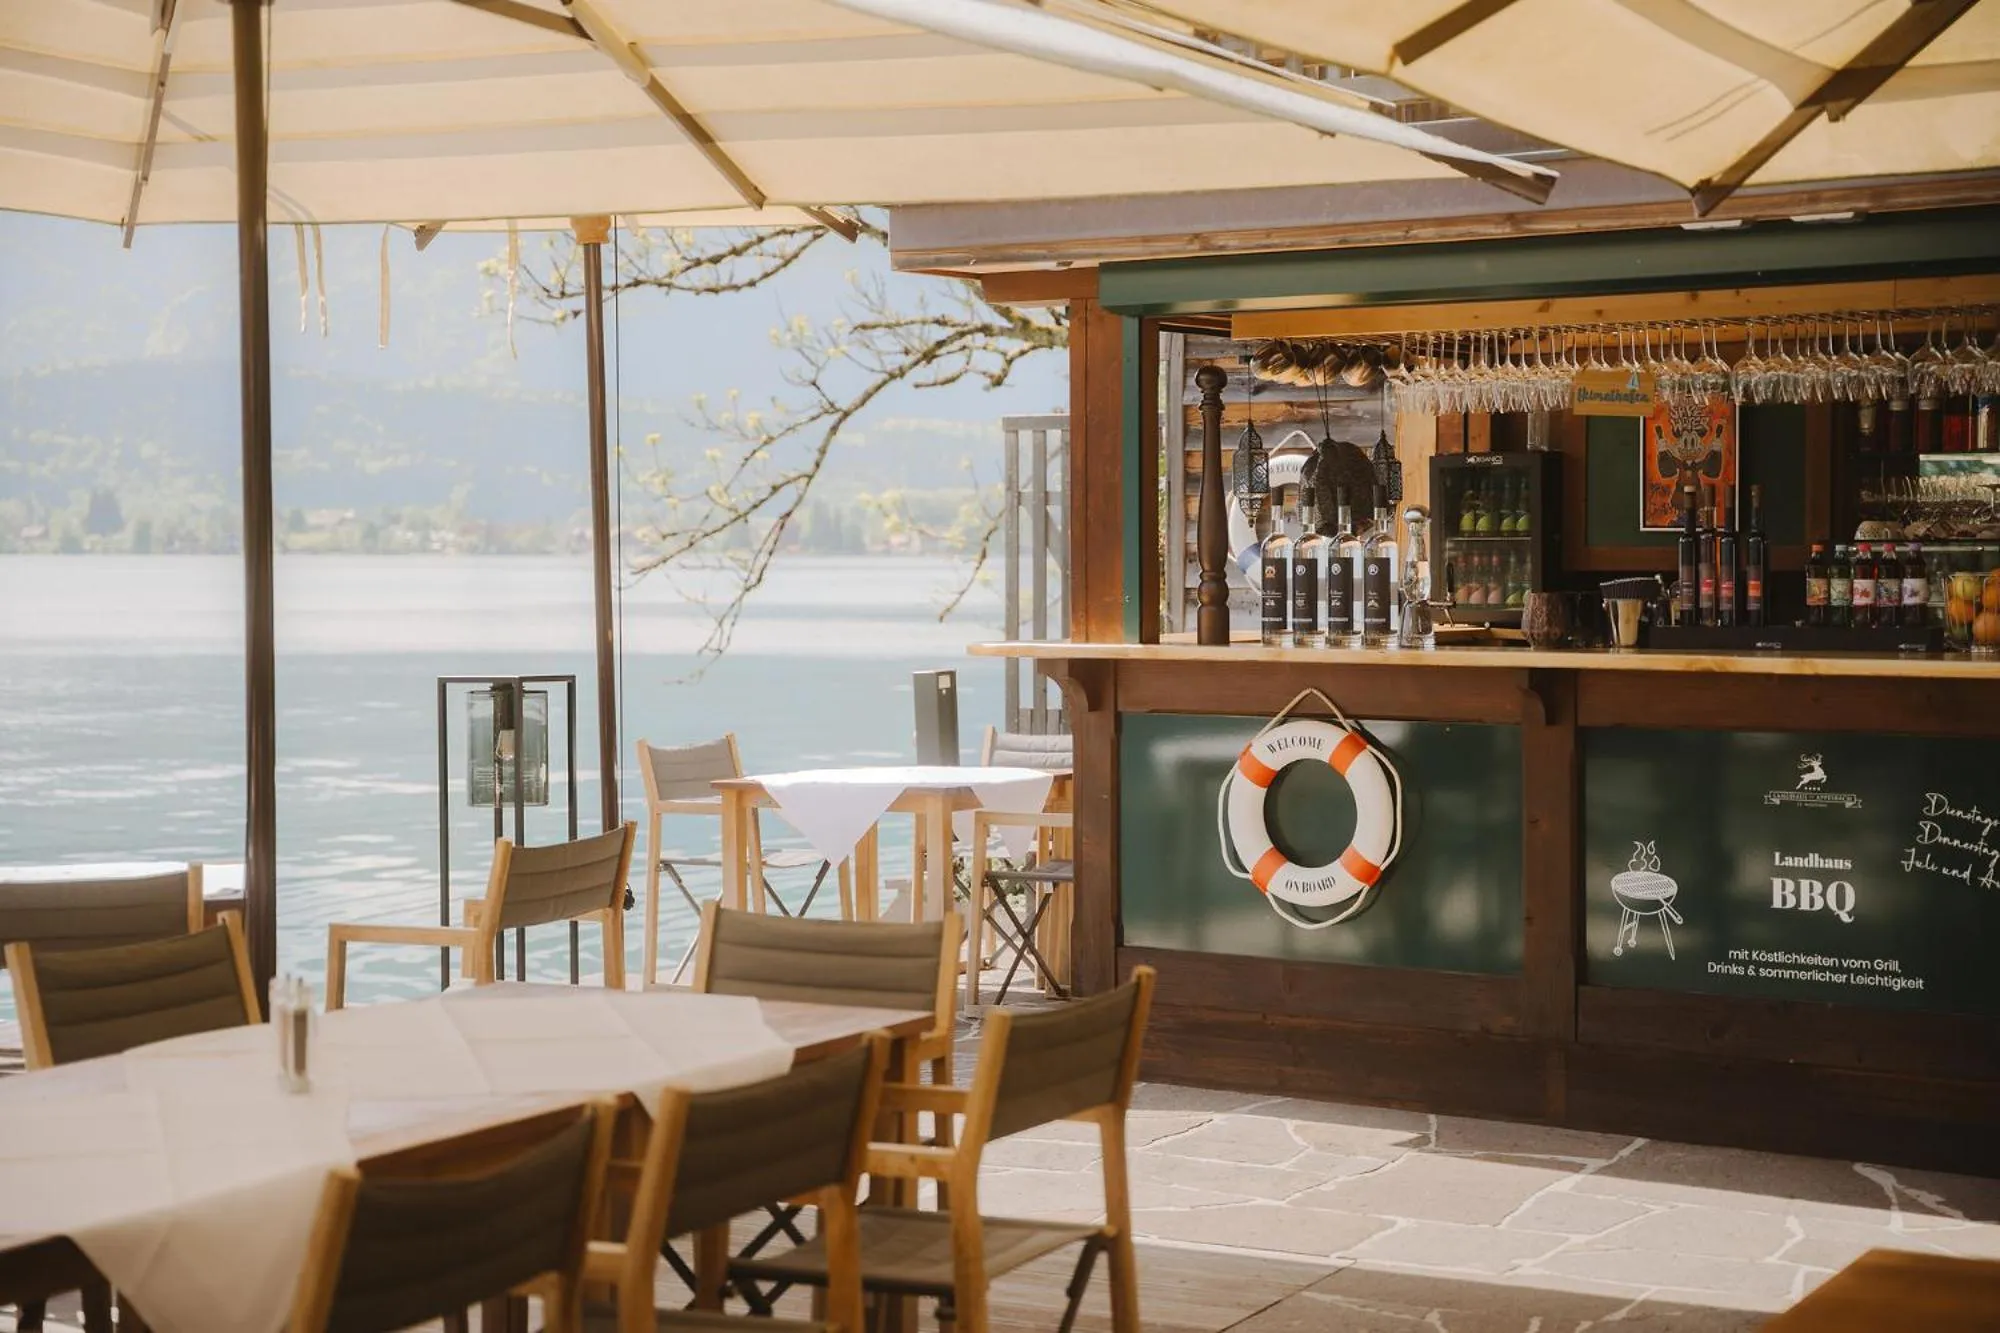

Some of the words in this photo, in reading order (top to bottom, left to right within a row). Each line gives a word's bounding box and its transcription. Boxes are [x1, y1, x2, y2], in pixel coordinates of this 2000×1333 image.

[1266, 735, 1326, 754] WELCOME
[1773, 851, 1853, 870] Landhaus
[1901, 847, 1938, 872] Juli
[1942, 863, 1973, 886] und
[1770, 876, 1856, 923] BBQ
[1728, 949, 1749, 961] mit
[1751, 949, 1839, 967] Köstlichkeiten
[1841, 959, 1871, 970] vom
[1873, 959, 1902, 973] Grill,
[1707, 961, 1745, 976] Drinks
[1747, 965, 1756, 976] &
[1759, 965, 1848, 984] sommerlicher
[1850, 974, 1925, 991] Leichtigkeit
